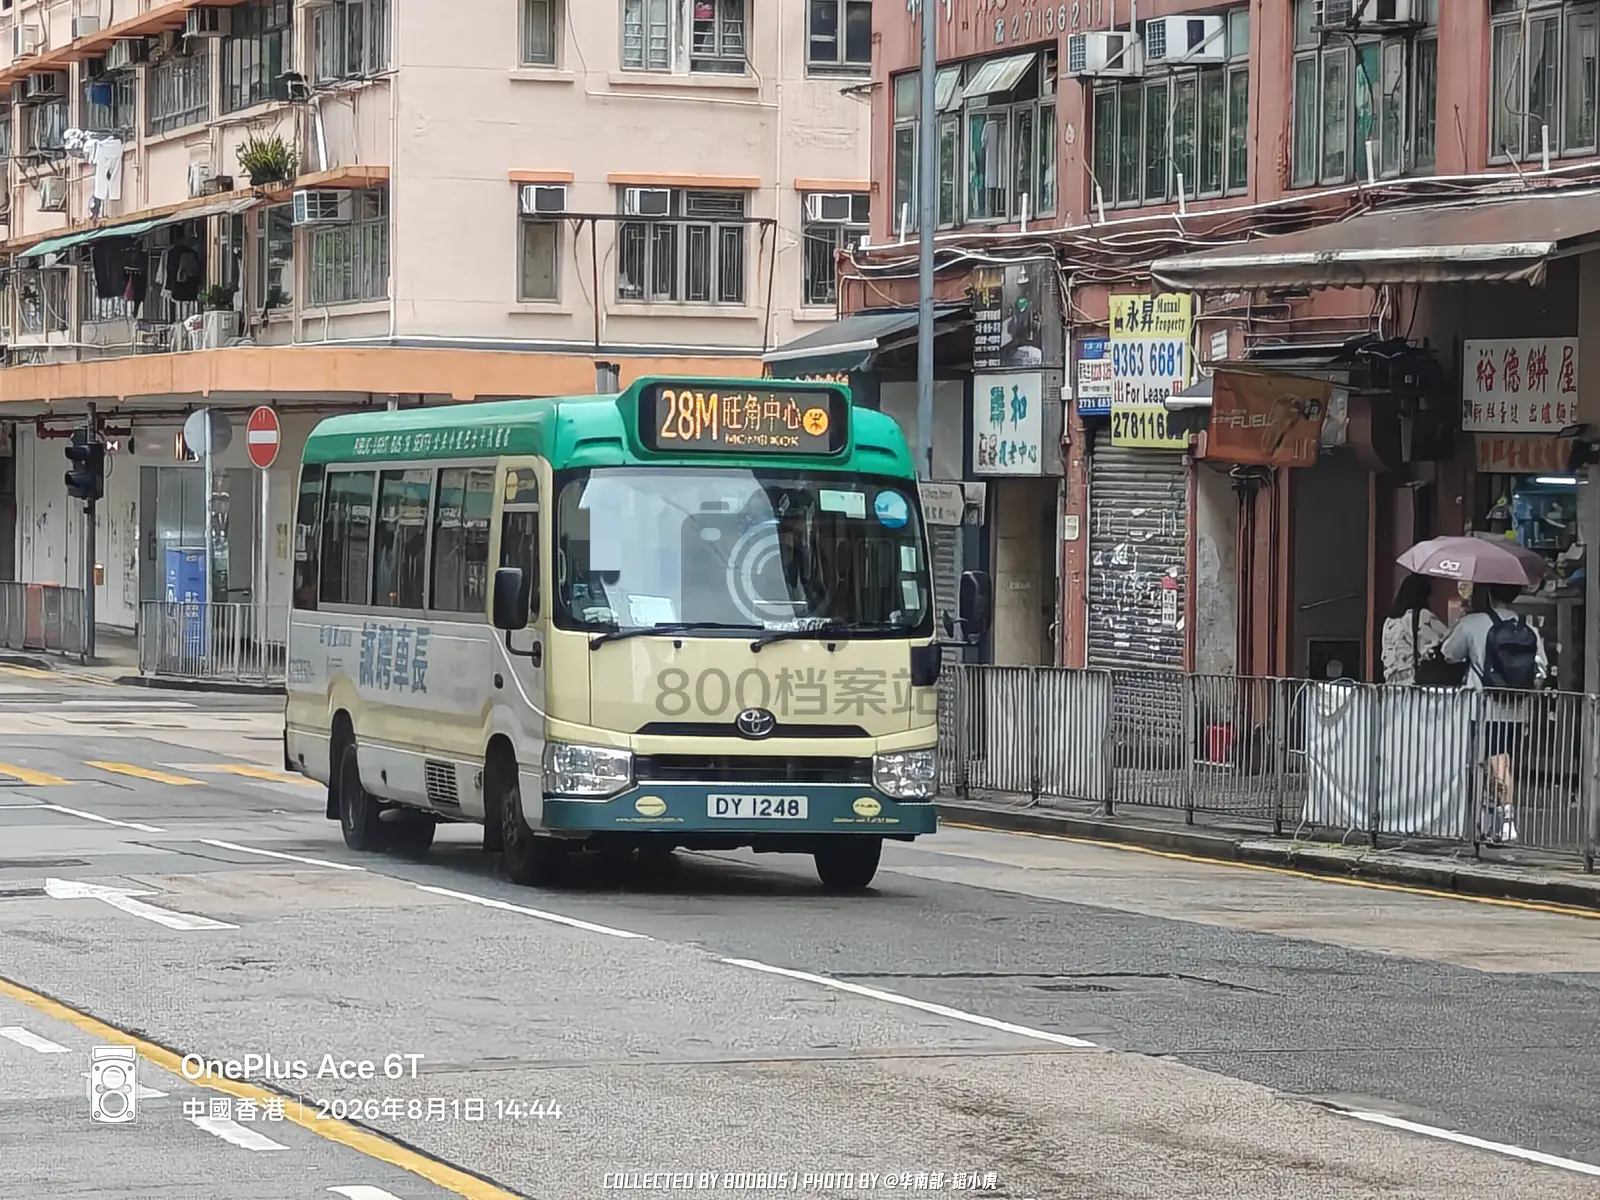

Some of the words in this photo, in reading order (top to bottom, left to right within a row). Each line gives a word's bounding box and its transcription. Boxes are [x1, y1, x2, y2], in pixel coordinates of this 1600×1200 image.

[1126, 300, 1155, 332] 永昇
[1155, 316, 1186, 333] Property
[1113, 343, 1144, 377] 9363
[1150, 342, 1183, 376] 6681
[1476, 344, 1577, 394] 裕德餅屋
[1126, 383, 1140, 403] For
[660, 389, 718, 441] 28M
[722, 394, 801, 431] 旺角中心
[1113, 412, 1184, 440] 278116
[715, 797, 742, 816] DY
[752, 798, 800, 817] 1248
